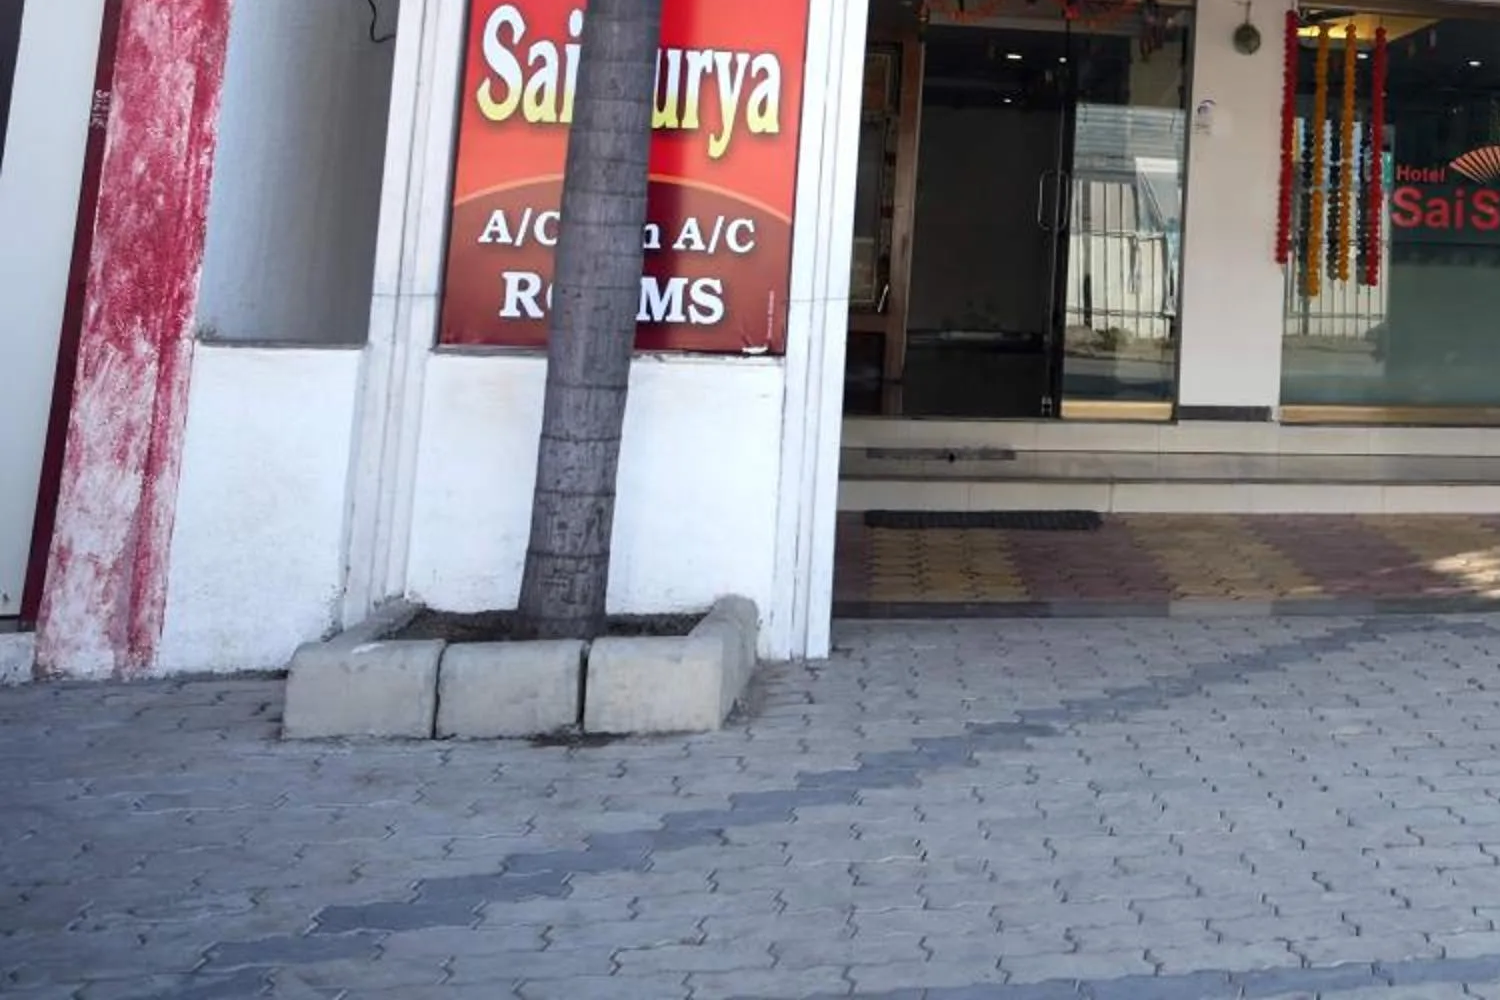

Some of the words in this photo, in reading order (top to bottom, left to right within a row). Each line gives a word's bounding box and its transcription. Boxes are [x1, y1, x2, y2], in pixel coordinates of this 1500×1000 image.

[476, 3, 584, 123] Sai
[652, 47, 782, 160] urya
[1396, 164, 1448, 183] Hotel
[478, 207, 561, 247] A/C
[672, 215, 756, 254] A/C
[1391, 185, 1465, 229] Sai
[499, 270, 725, 325] RMS
